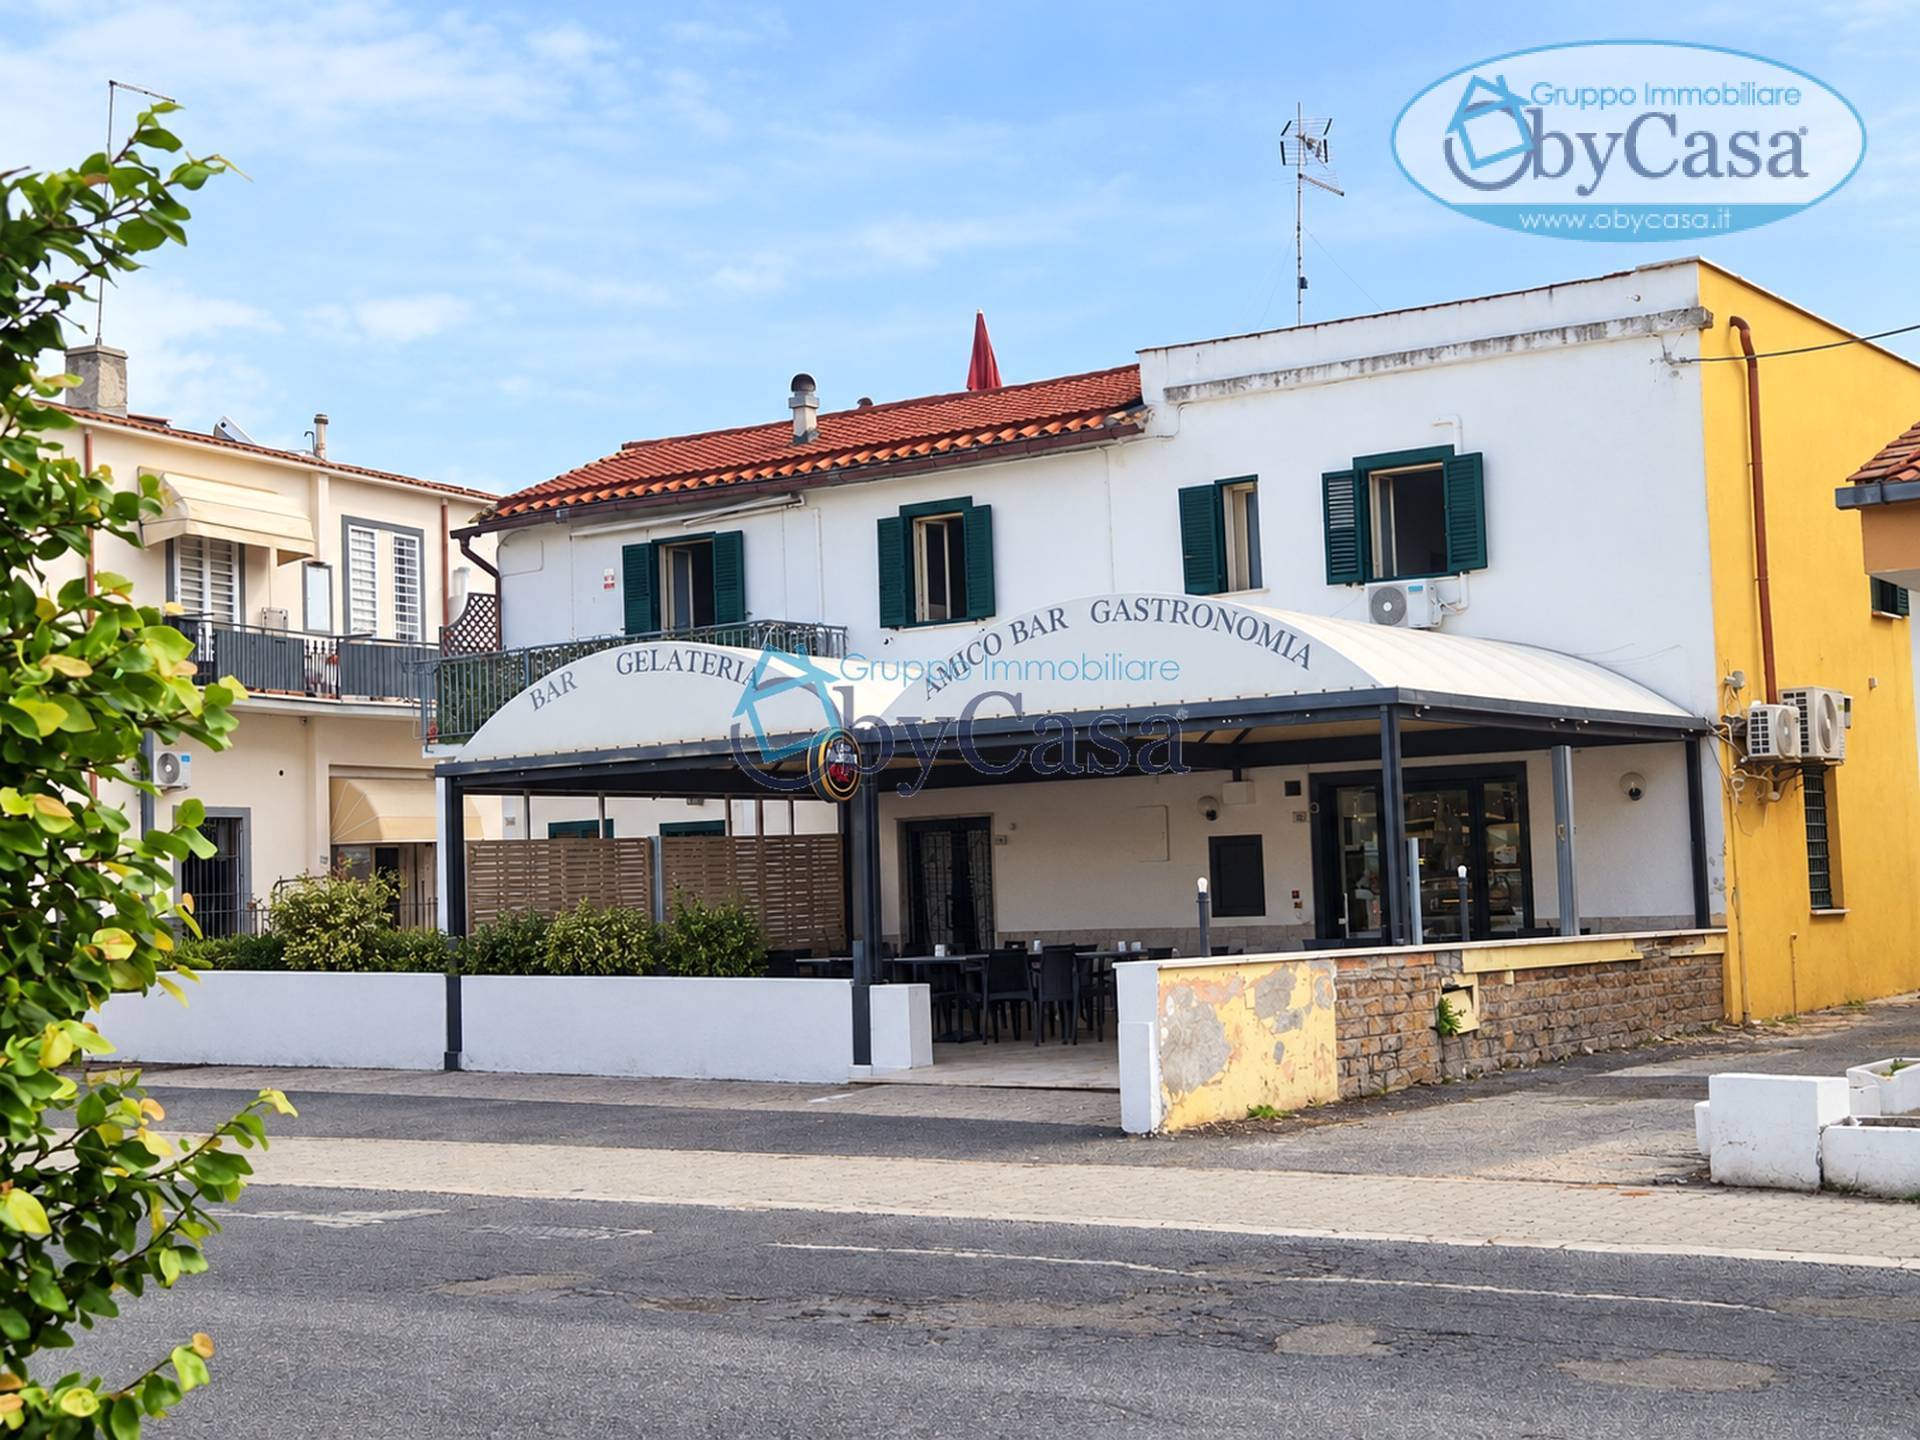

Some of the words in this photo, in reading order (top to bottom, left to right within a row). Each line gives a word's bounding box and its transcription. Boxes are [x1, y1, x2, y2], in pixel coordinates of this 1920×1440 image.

[530, 670, 578, 712] BAR
[616, 647, 759, 691] GELATERIA
[923, 631, 1003, 701] AMICO
[1008, 606, 1070, 645] BAR
[1090, 597, 1311, 671] GASTRONOMIA
